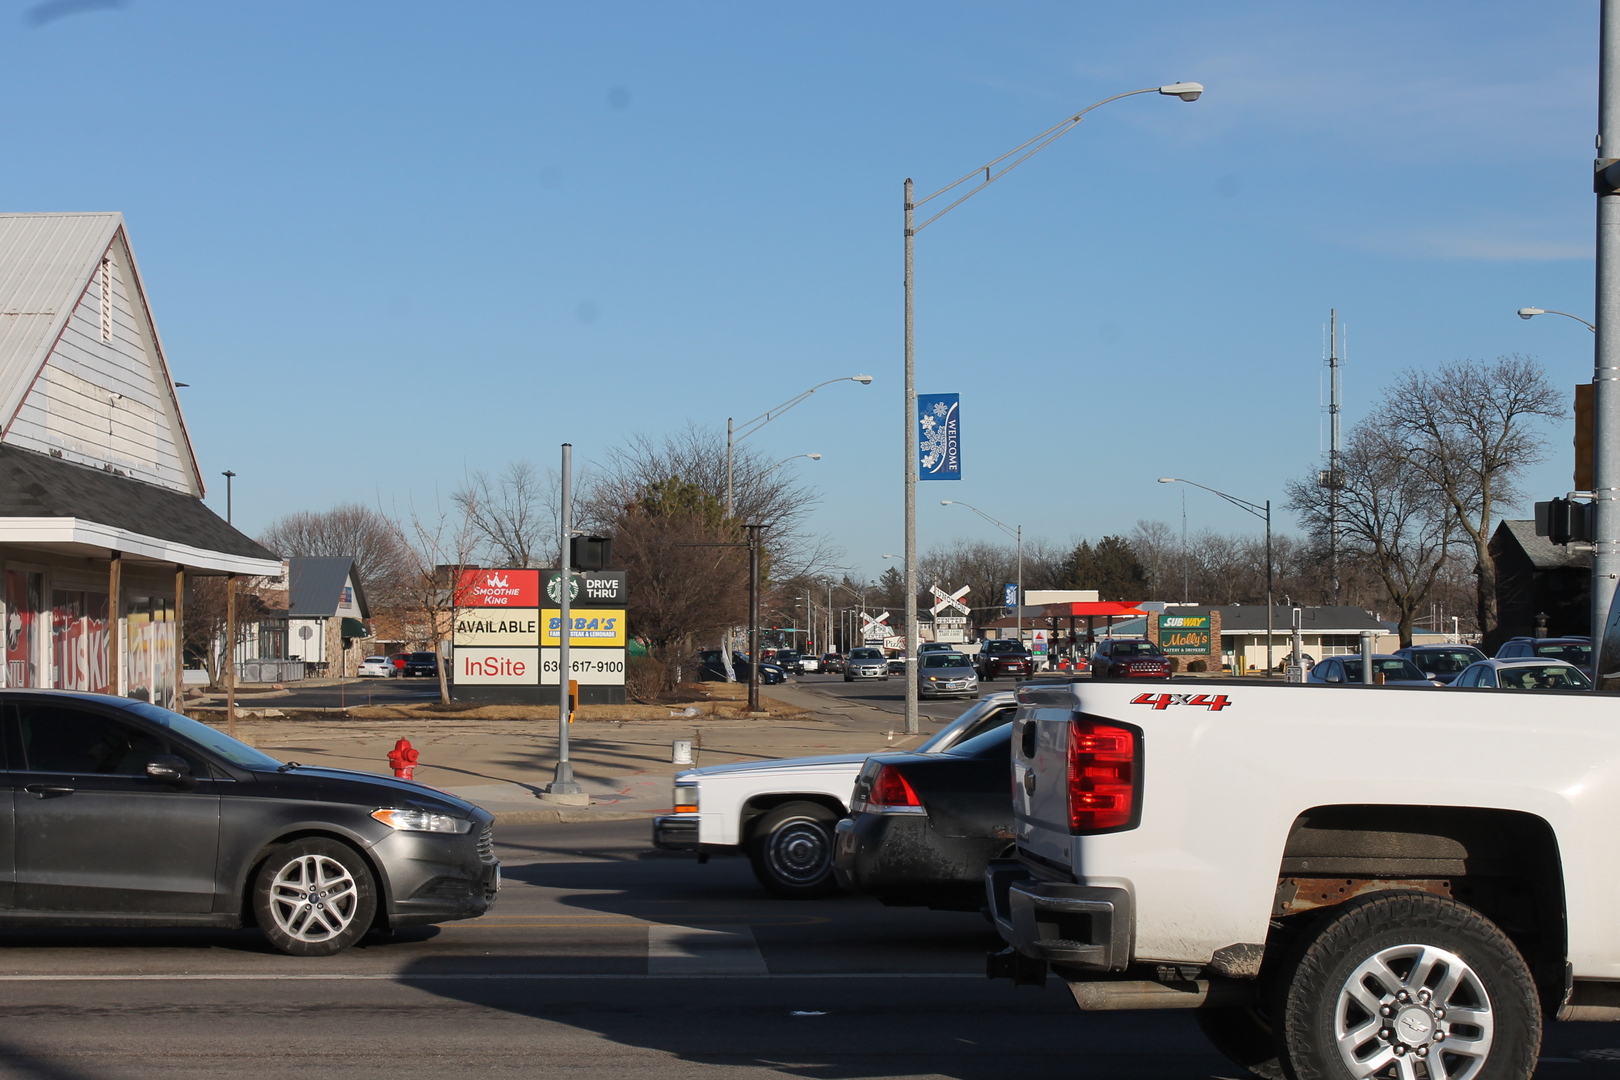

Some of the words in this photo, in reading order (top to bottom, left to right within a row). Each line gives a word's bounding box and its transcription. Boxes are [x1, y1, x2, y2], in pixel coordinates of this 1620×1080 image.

[948, 419, 957, 470] WELCOME
[586, 579, 619, 589] DRIVE
[473, 587, 520, 596] SMOOTHIE
[587, 589, 617, 598] THRU
[934, 588, 966, 613] UNCTION
[457, 620, 536, 633] AVAILABLE
[1163, 617, 1206, 627] SUBWAY
[1162, 632, 1208, 647] Molly's
[465, 657, 525, 676] InSite
